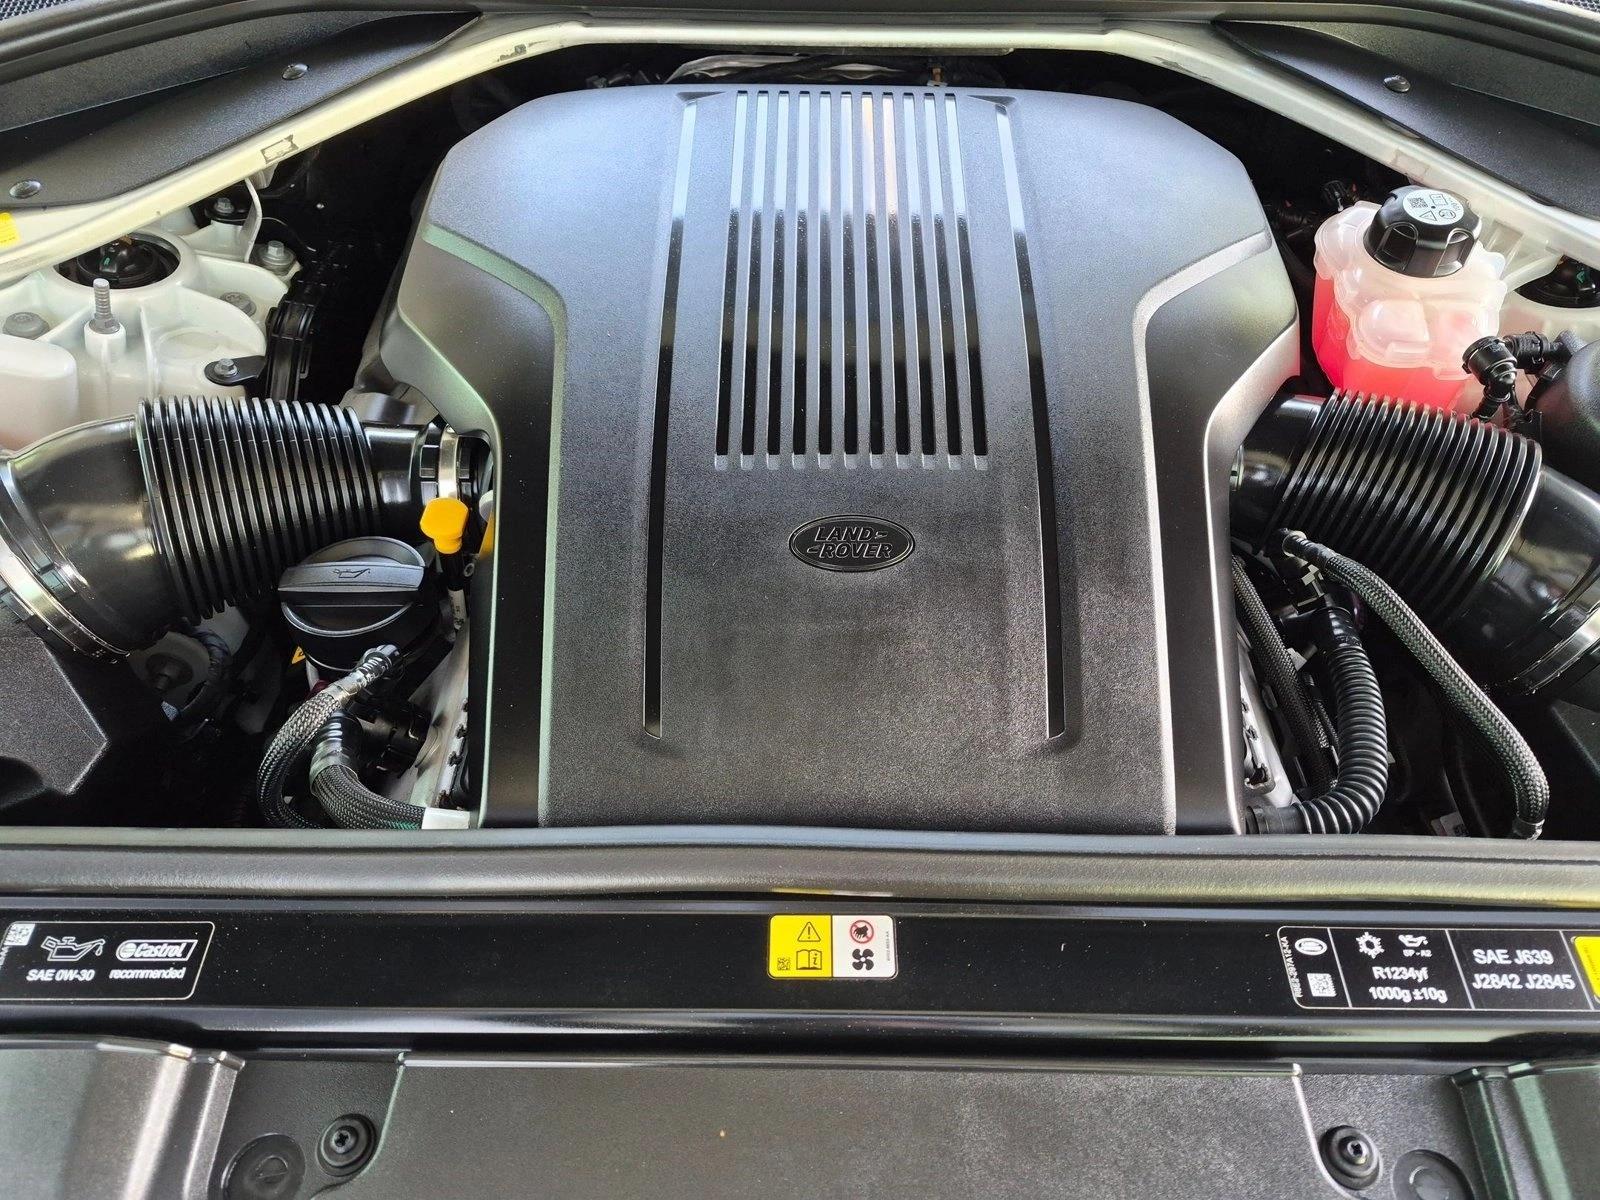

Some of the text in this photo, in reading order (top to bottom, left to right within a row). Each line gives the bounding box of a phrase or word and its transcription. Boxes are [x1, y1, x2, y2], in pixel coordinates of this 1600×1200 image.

[814, 526, 874, 541] LAND
[819, 542, 893, 559] ROVER
[134, 942, 187, 958] Castrol
[1472, 948, 1554, 965] SAE J639
[26, 968, 96, 982] SAE 0W-30
[109, 967, 186, 979] recommended
[1372, 966, 1429, 983] R1234yf
[1472, 973, 1576, 990] J2842 J2845
[1369, 986, 1448, 1003] 1000g ±10g
